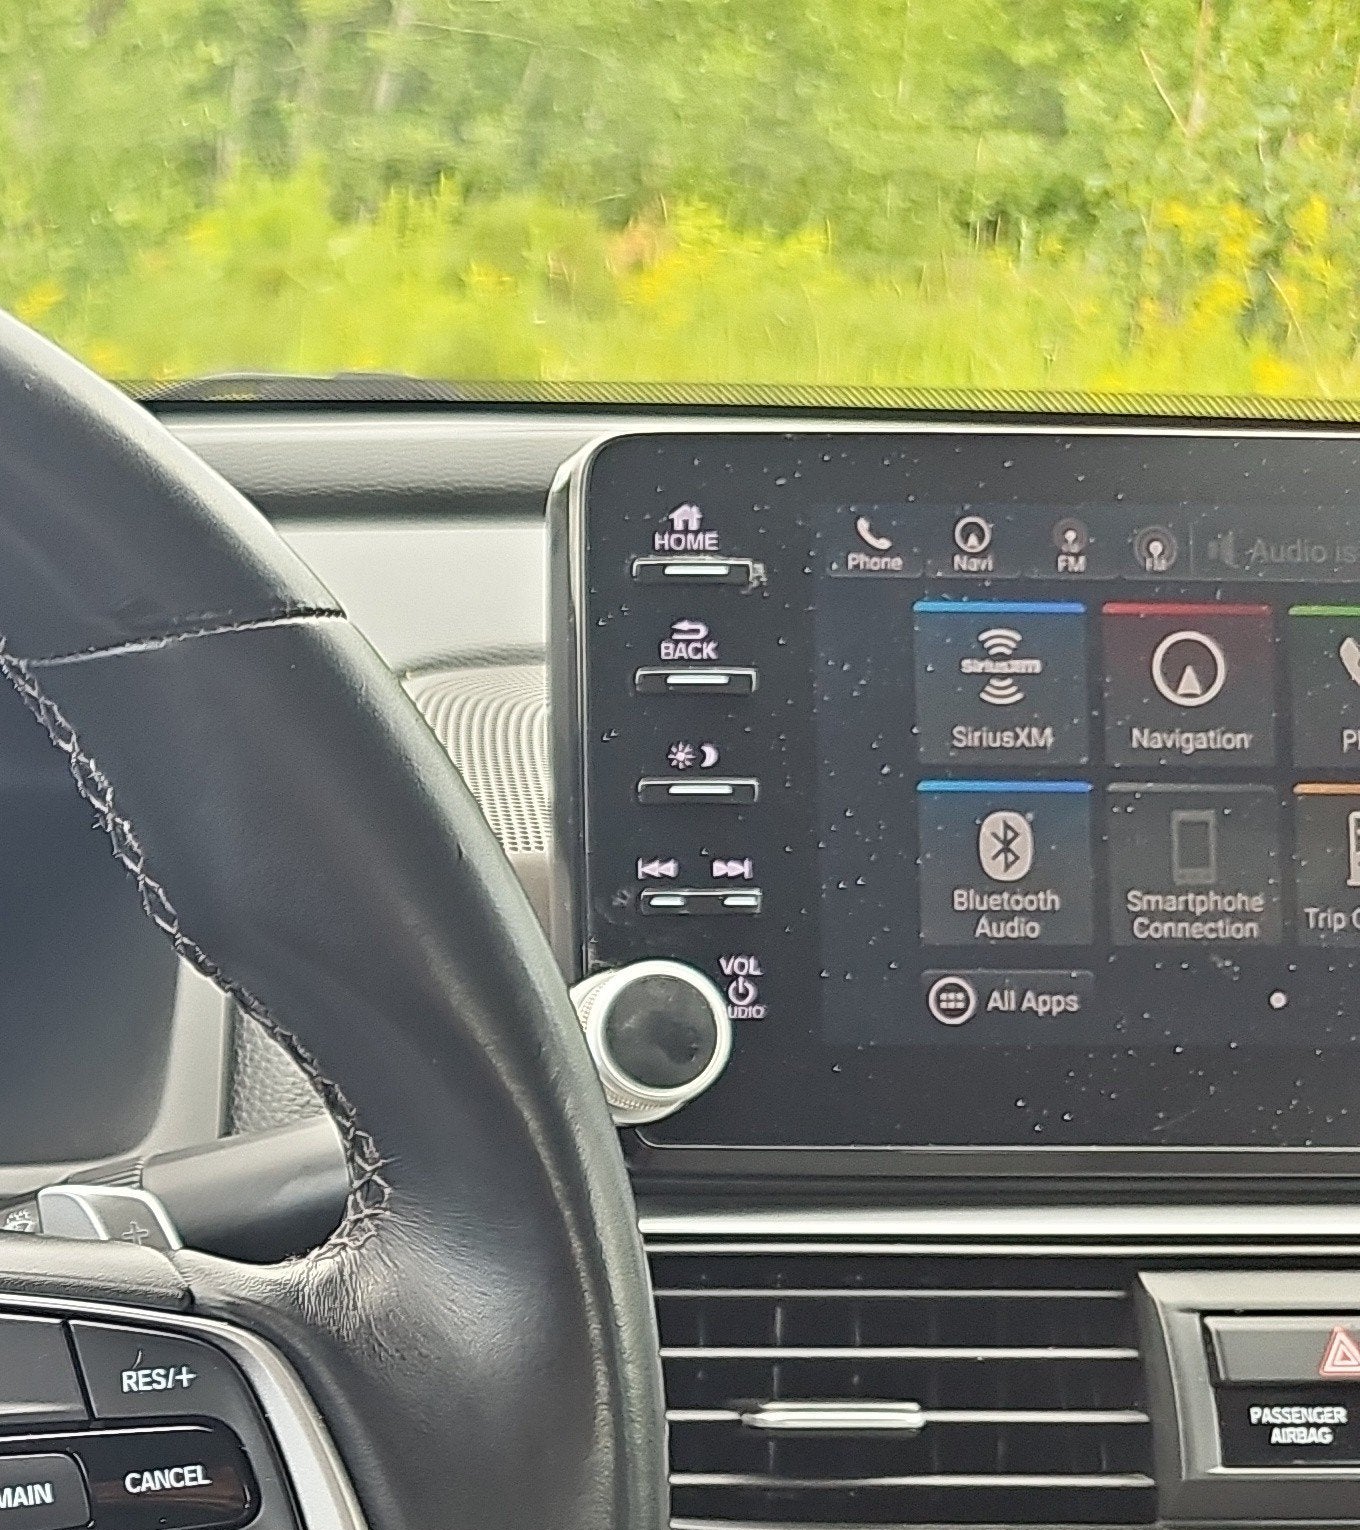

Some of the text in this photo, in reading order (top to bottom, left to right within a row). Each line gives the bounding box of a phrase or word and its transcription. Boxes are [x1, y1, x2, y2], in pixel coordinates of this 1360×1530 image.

[653, 530, 720, 552] HOME
[1251, 537, 1327, 564] Audio
[846, 551, 904, 572] Phone
[952, 553, 994, 573] Navi
[1056, 554, 1087, 574] FM
[660, 641, 719, 662] BACK
[951, 726, 1054, 750] SiriusXM
[1130, 727, 1252, 754] Navigation
[952, 889, 1060, 912] Bluetooth
[1126, 889, 1265, 915] Smartphone
[974, 916, 1041, 939] Audio
[1132, 918, 1259, 941] Connection
[1304, 907, 1346, 932] Trip
[718, 955, 765, 976] VOL
[726, 1004, 768, 1020] UDIO
[986, 990, 1079, 1016] All Apps
[120, 1366, 197, 1394] RES/+
[1249, 1406, 1348, 1425] PASSENGER
[1270, 1426, 1333, 1446] AIRBAG
[124, 1464, 211, 1495] CANCEL
